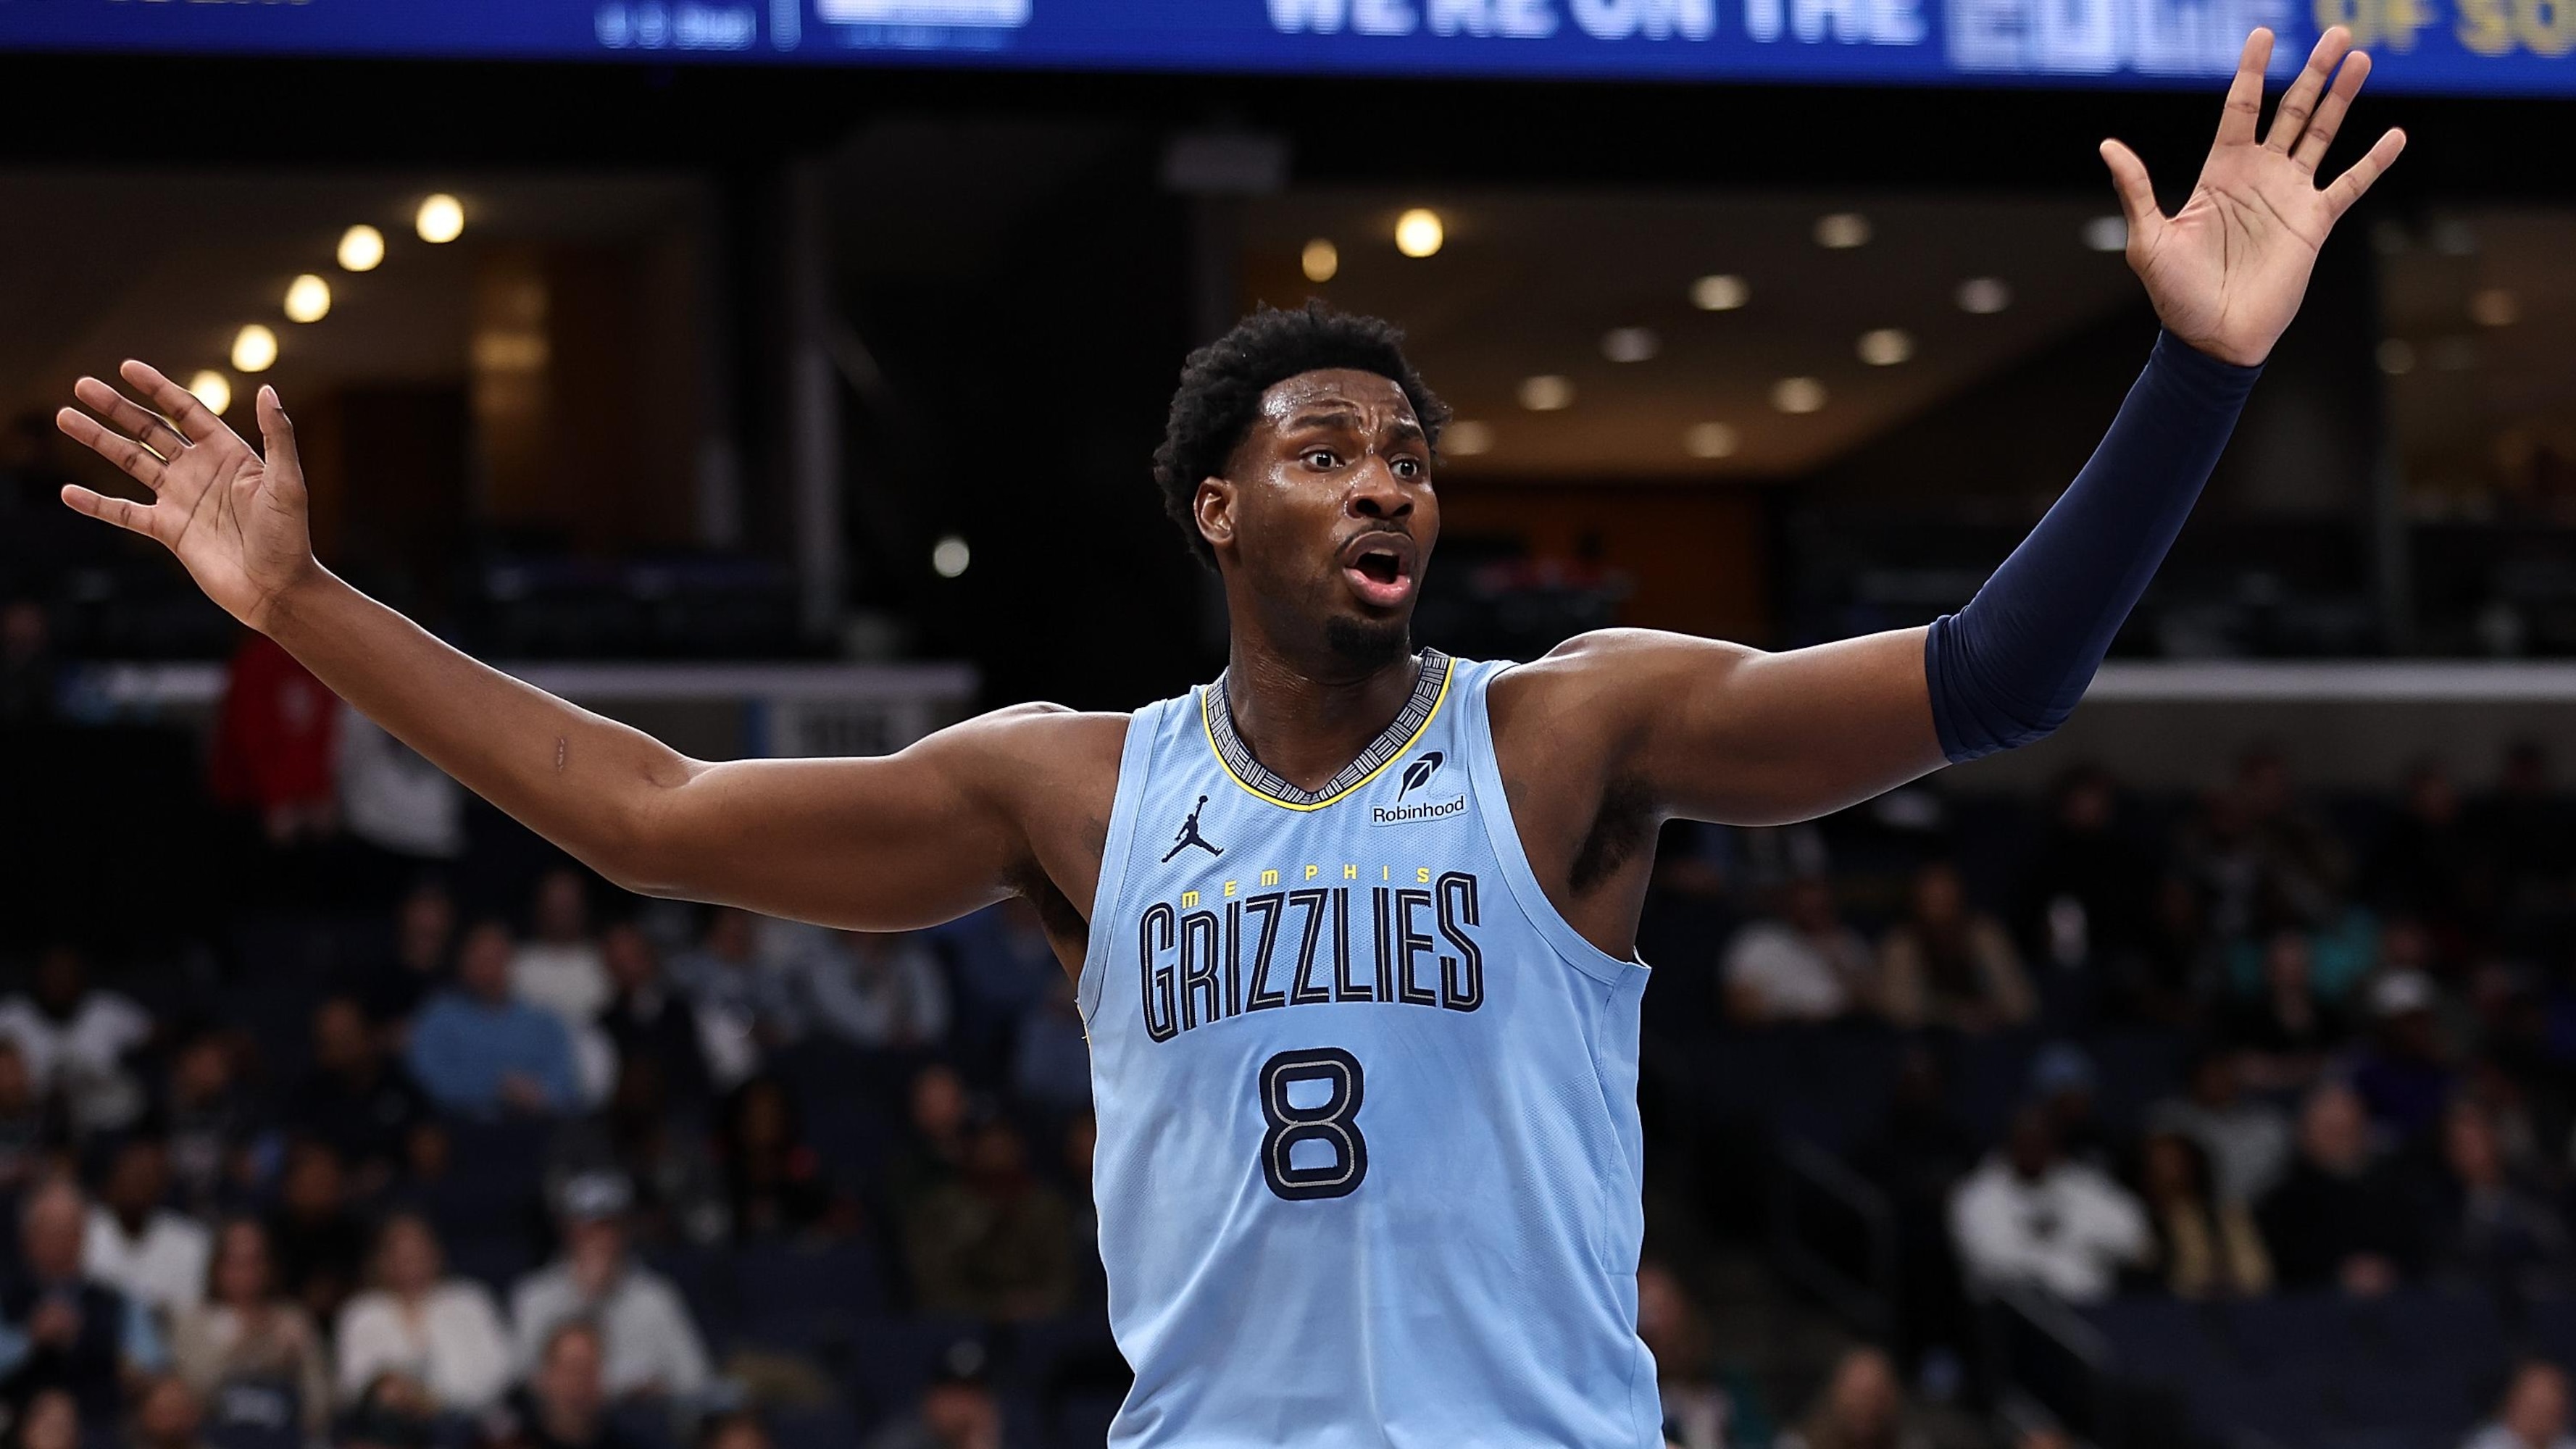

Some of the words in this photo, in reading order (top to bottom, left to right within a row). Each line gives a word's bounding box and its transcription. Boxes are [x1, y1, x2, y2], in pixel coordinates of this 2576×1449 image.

[1268, 0, 1559, 38] WERE
[1746, 0, 1928, 46] THE
[1373, 797, 1464, 822] Robinhood
[1181, 865, 1430, 909] MEMPHIS
[1140, 872, 1485, 1043] GRIZZLIES
[1259, 1048, 1368, 1200] 8
